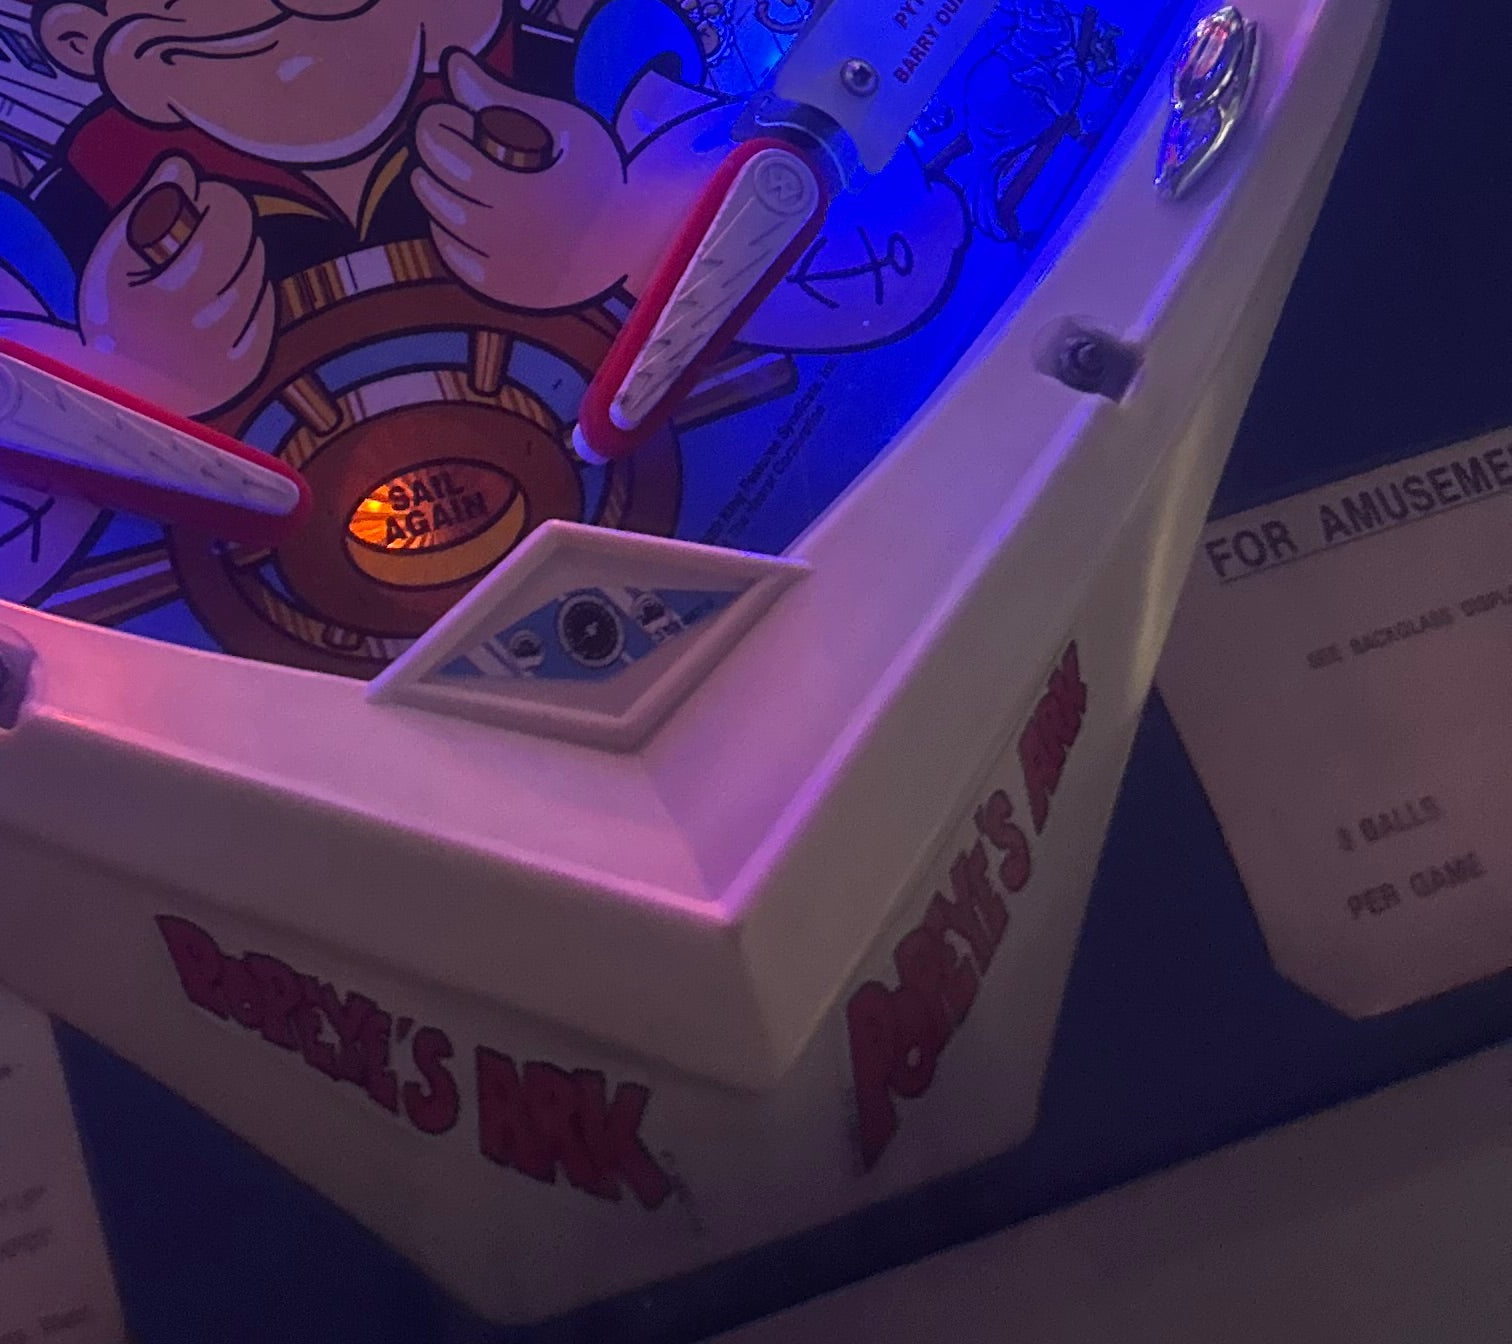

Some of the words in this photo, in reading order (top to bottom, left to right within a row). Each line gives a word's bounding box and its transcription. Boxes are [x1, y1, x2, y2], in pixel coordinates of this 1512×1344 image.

[892, 22, 941, 84] BARRY
[387, 492, 488, 543] AGAIN
[388, 472, 465, 511] SAIL
[1204, 518, 1299, 578] FOR
[153, 913, 463, 1135] POPEYE'S
[473, 1043, 671, 1212] ARK
